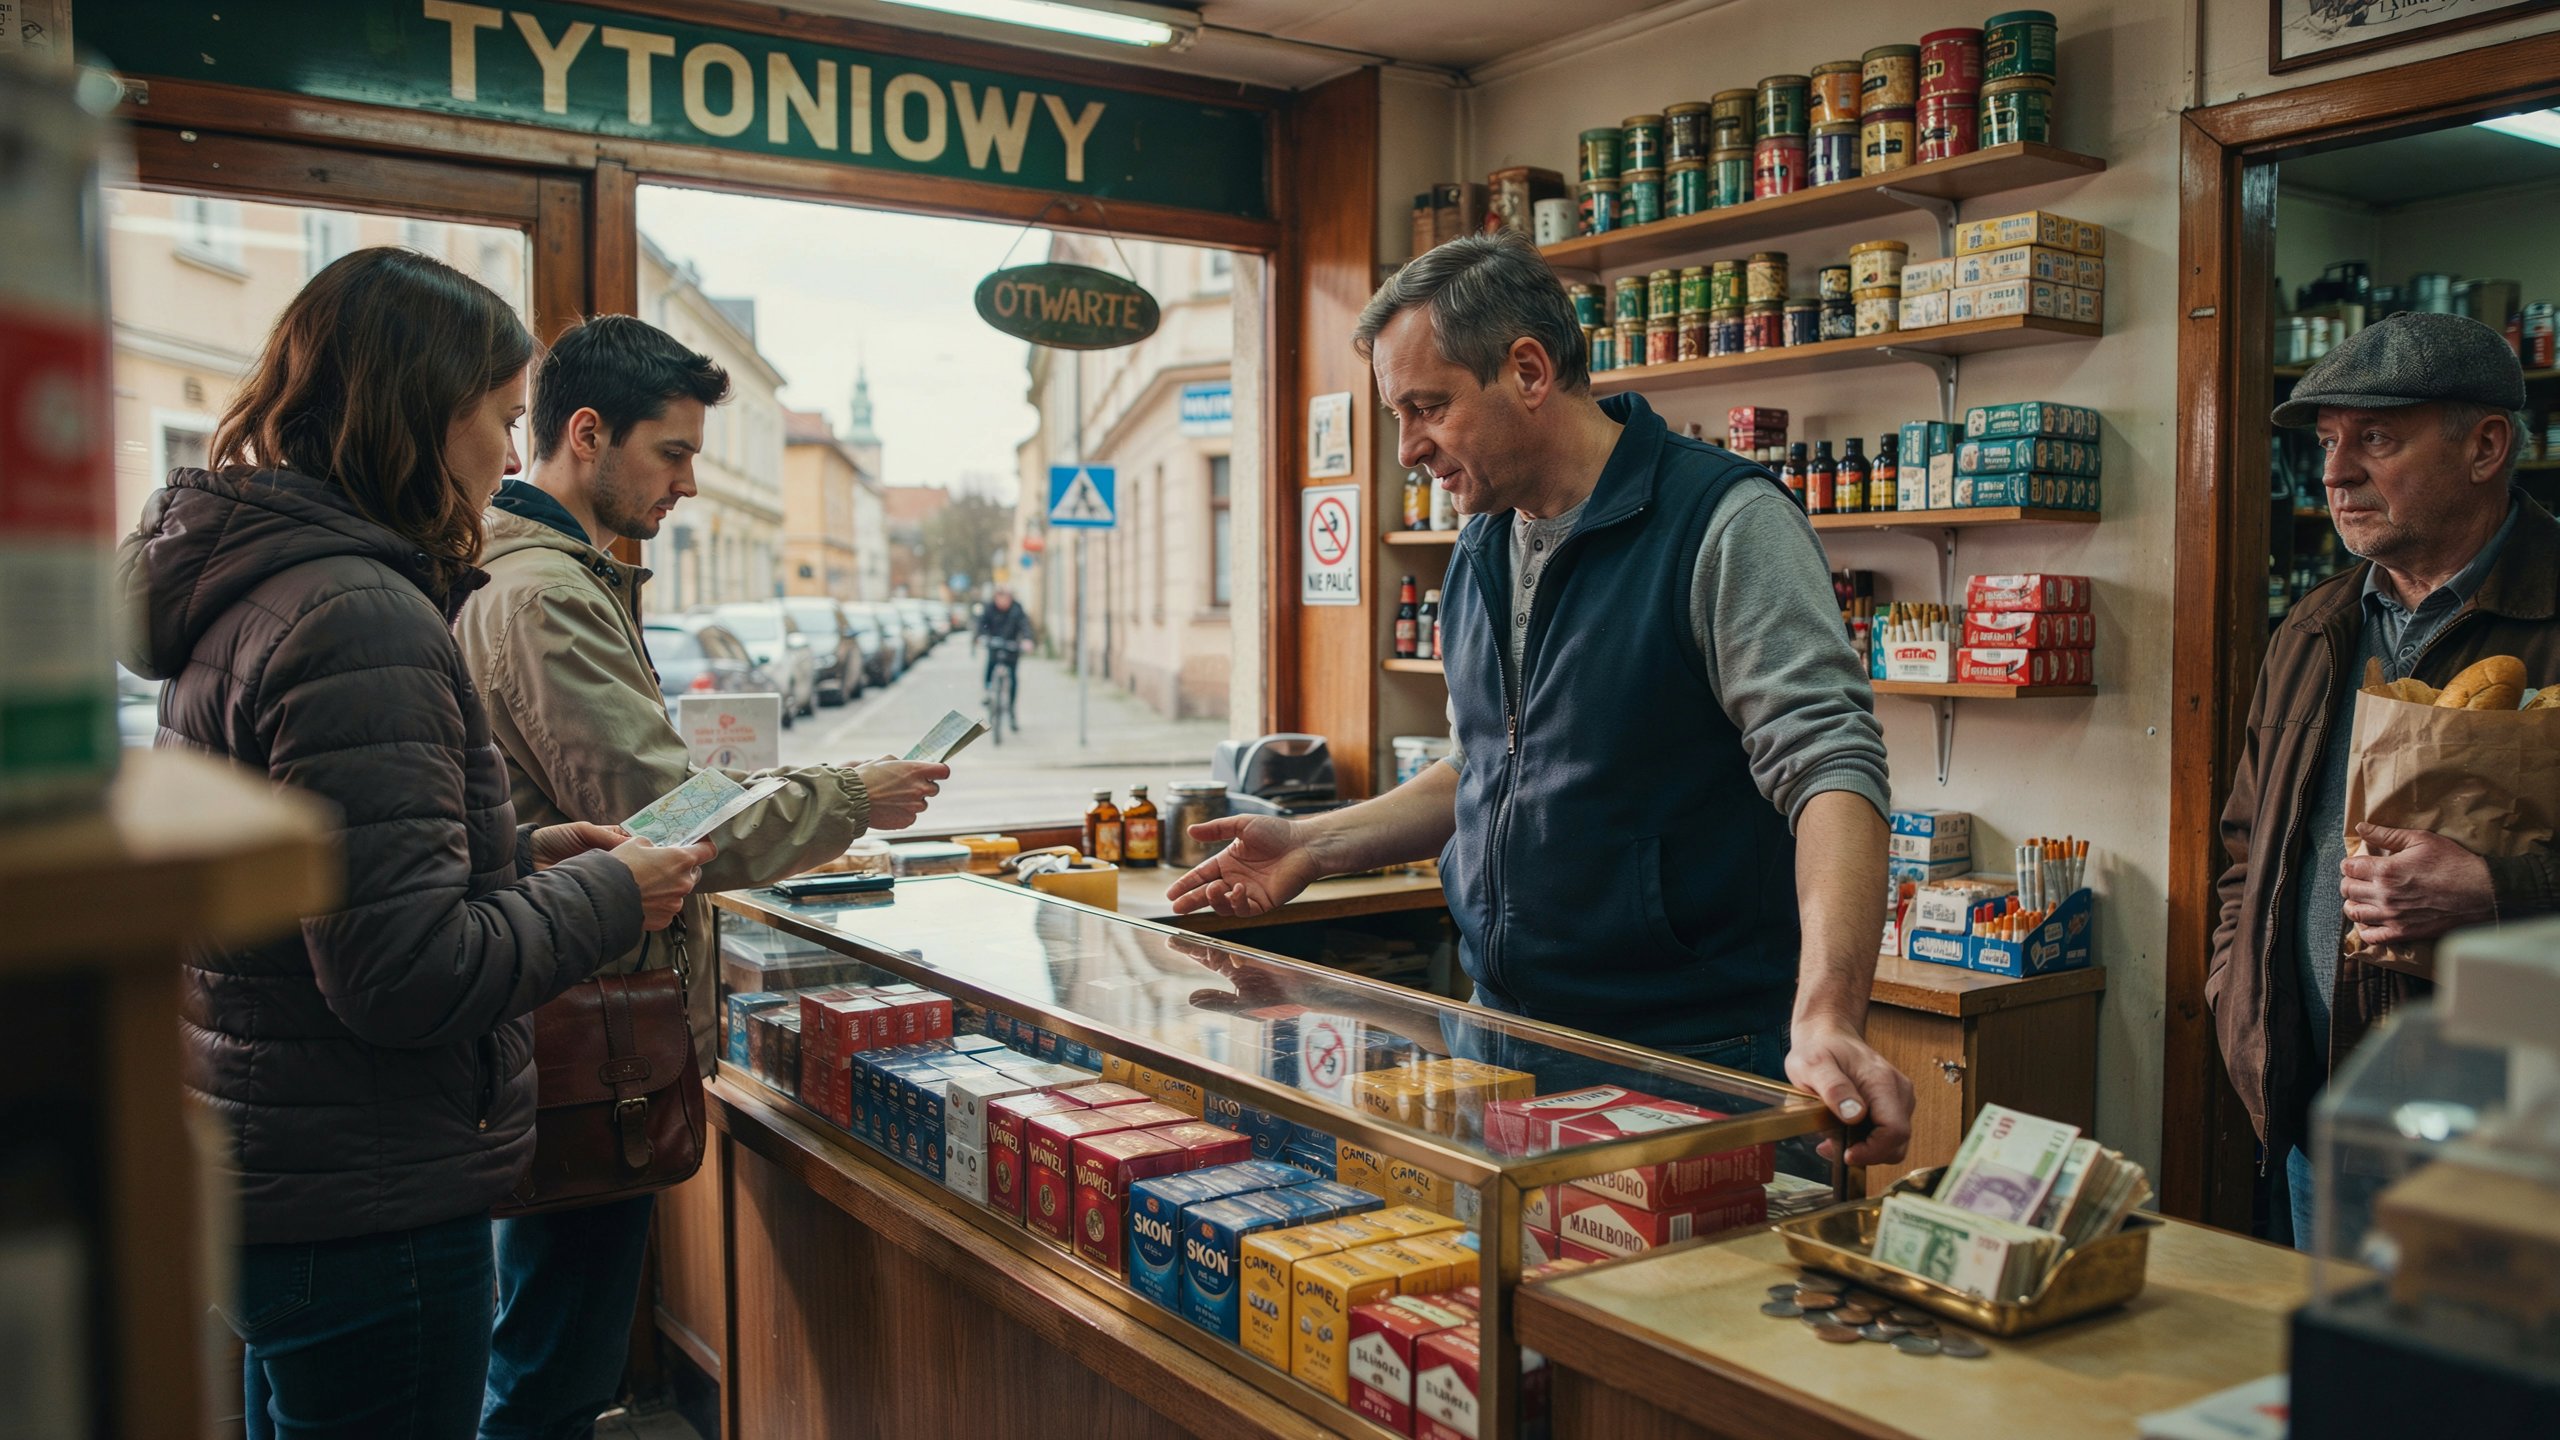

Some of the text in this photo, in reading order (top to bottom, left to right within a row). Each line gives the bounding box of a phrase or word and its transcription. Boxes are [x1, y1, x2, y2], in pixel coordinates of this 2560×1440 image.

[423, 6, 1107, 182] TYTONIOWY
[994, 280, 1141, 330] OTWARTE
[1308, 568, 1352, 592] NIE PALIĆ
[1163, 1079, 1198, 1100] CAMEL
[1341, 1146, 1382, 1175] CAMEL
[1075, 1164, 1117, 1201] WAWEL
[1390, 1166, 1431, 1192] CAMEL
[1569, 1213, 1644, 1253] MARLBORO
[1244, 1255, 1285, 1289] CAMEL
[1296, 1280, 1341, 1314] CAMEL
